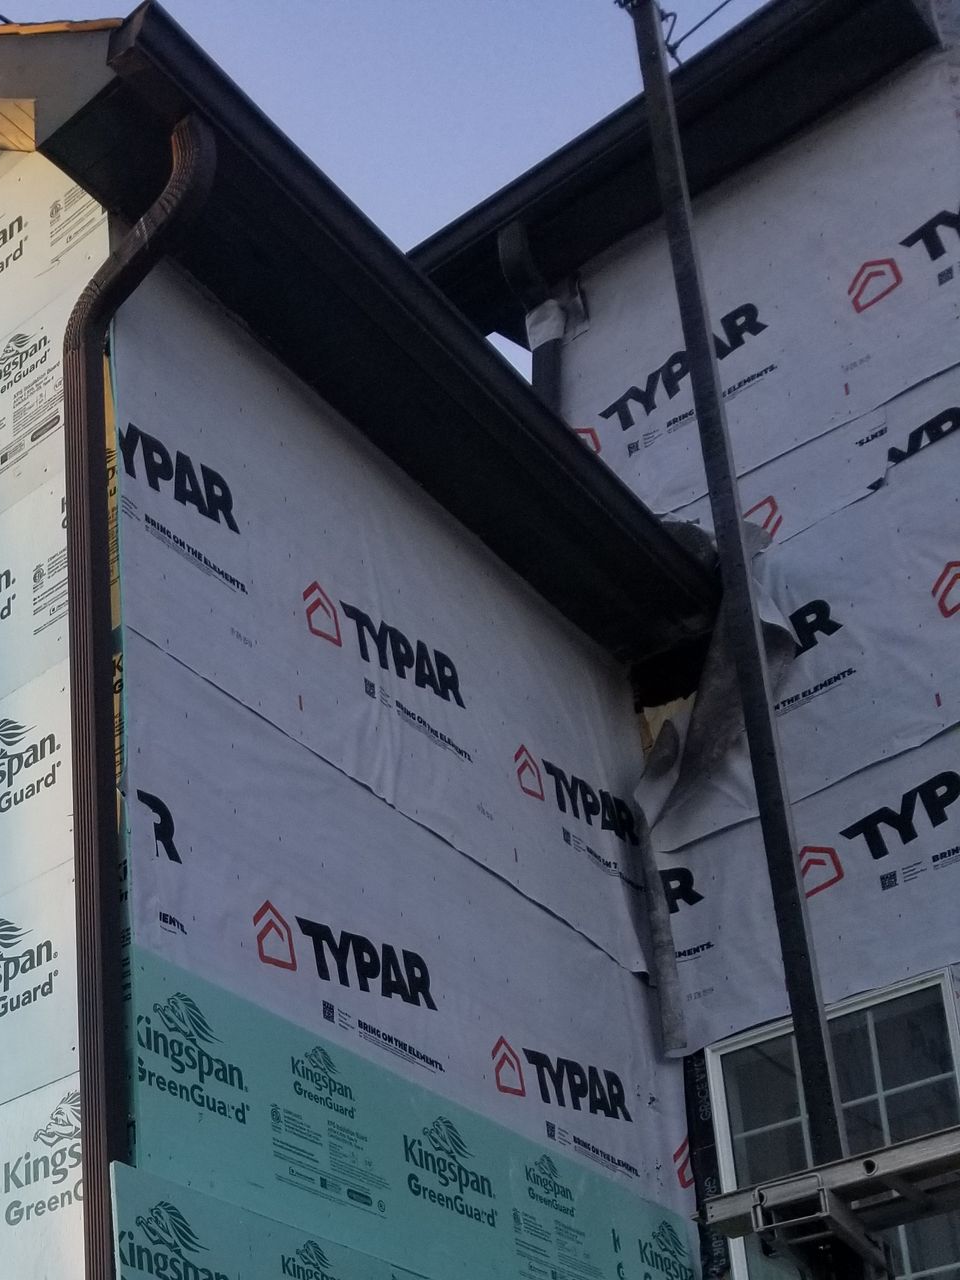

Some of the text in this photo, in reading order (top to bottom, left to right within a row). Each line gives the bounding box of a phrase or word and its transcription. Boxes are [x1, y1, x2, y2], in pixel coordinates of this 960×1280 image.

[599, 302, 768, 430] TYPR
[119, 422, 240, 535] YPAR
[340, 600, 466, 710] TYPAR
[840, 770, 960, 860] TYP
[295, 915, 438, 1011] TYPAR
[291, 1056, 353, 1101] Kingspan
[293, 1082, 355, 1119] GreenGuard
[521, 1047, 634, 1123] TYPAR
[4, 1143, 81, 1193] Kings
[404, 1134, 494, 1201] Kingspan
